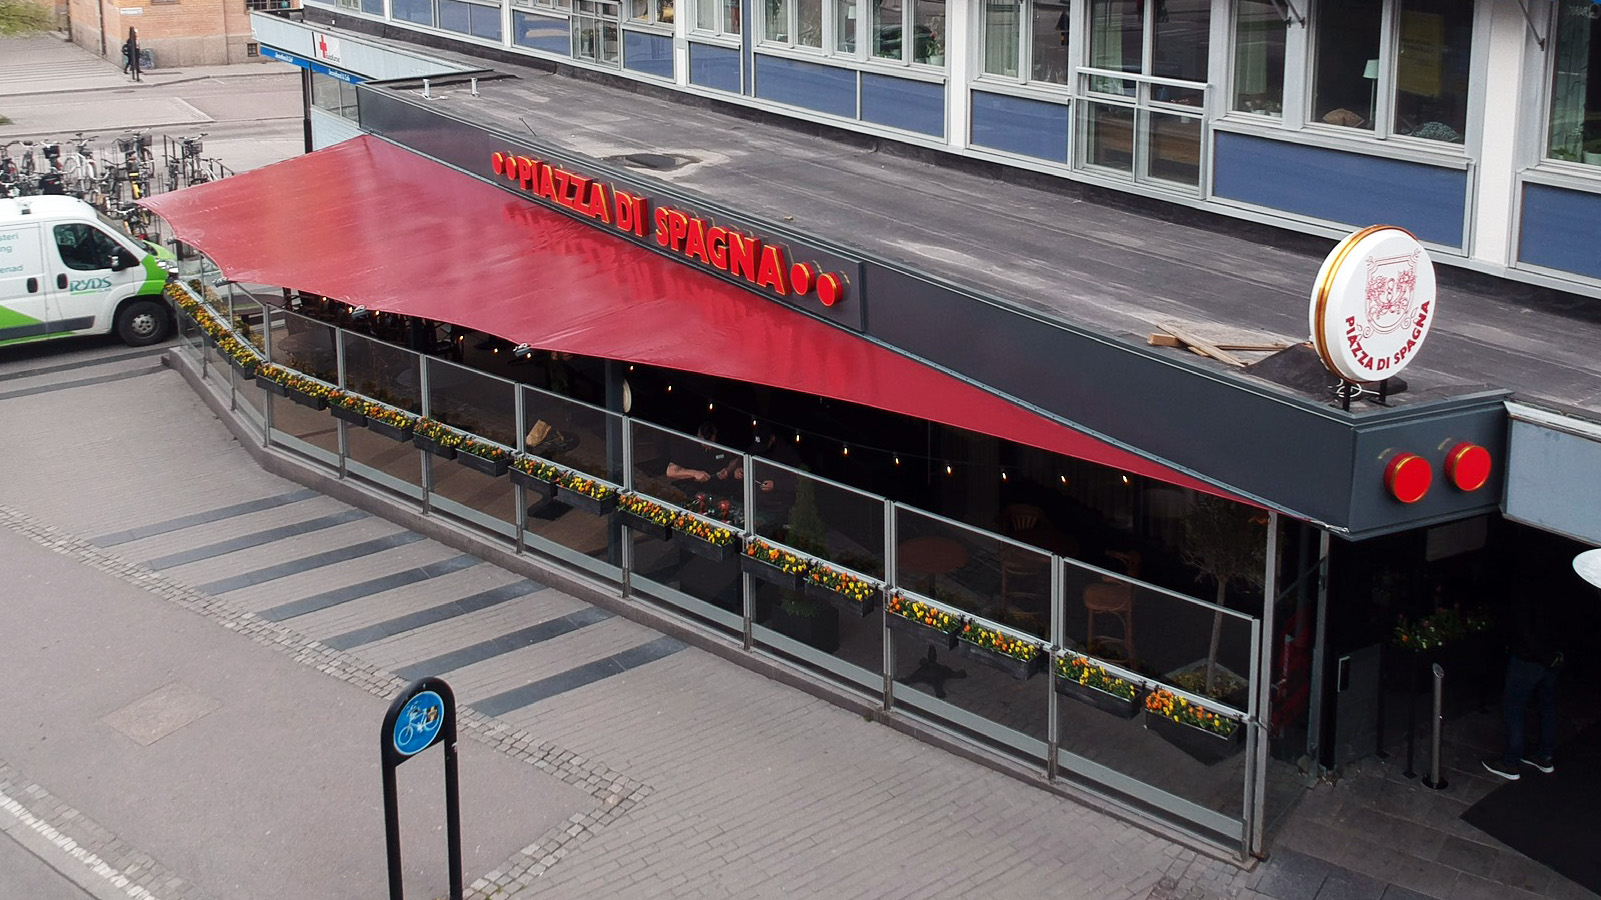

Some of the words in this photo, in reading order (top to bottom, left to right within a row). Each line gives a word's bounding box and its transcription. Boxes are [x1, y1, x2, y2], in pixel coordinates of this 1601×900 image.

[517, 155, 613, 225] PIAZZA
[615, 190, 649, 238] DI
[655, 205, 790, 296] SPAGNA
[69, 275, 112, 292] RYDS
[1345, 315, 1374, 371] PIAZZA
[1377, 357, 1391, 371] DI
[1394, 300, 1430, 365] SPAGNA
